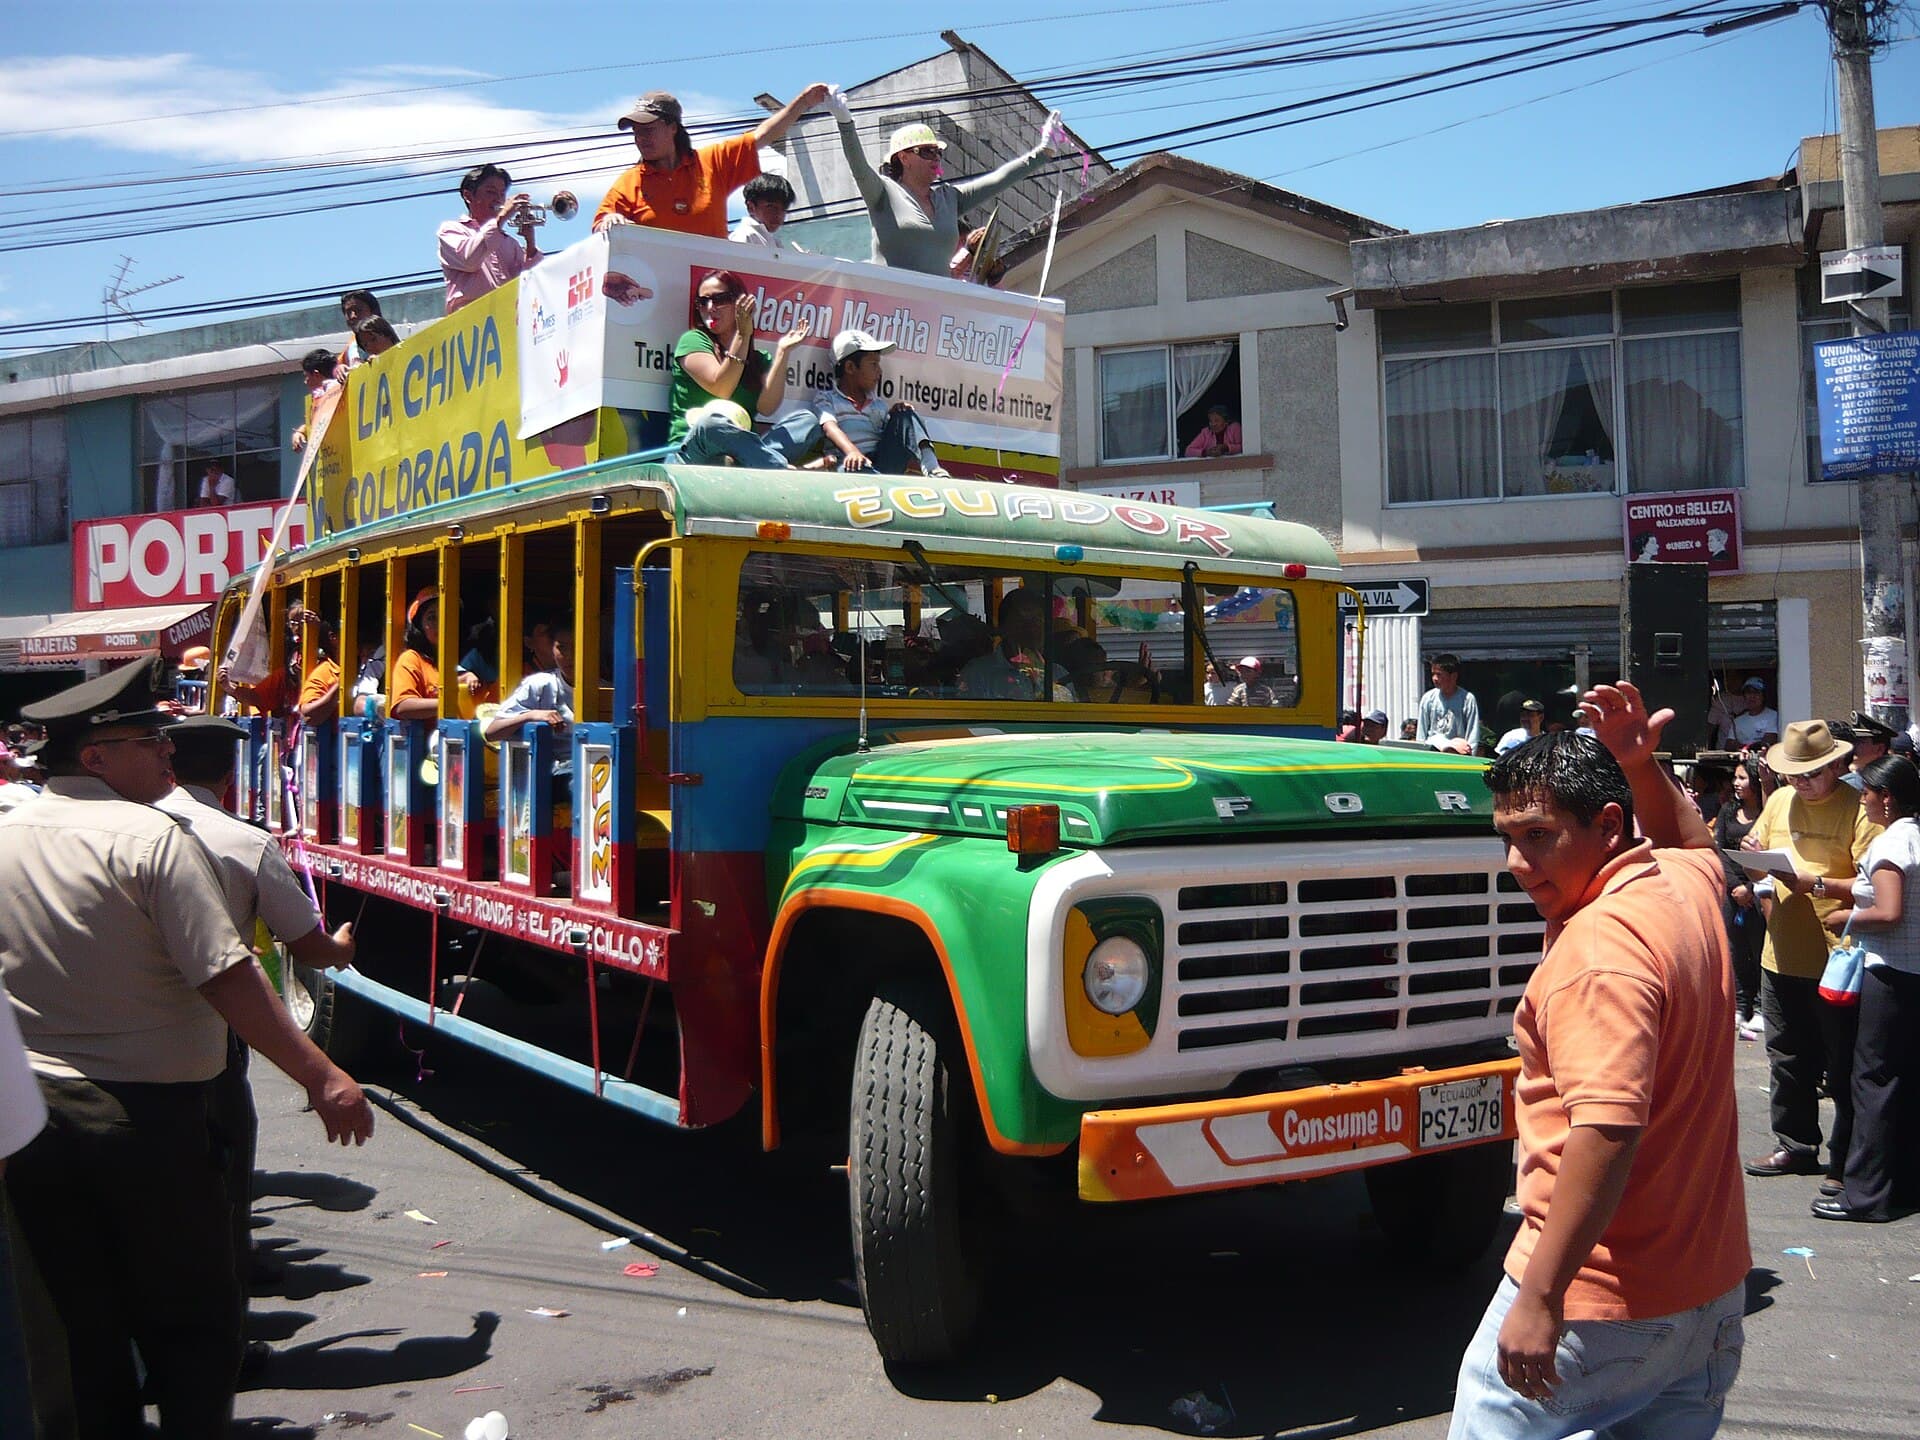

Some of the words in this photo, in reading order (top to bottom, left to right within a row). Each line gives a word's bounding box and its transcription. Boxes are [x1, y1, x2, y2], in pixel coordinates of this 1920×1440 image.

[752, 286, 833, 340] dacion
[841, 298, 930, 354] Martha
[936, 314, 1024, 369] Estrella
[1820, 342, 1860, 358] UNIDAD
[1863, 336, 1920, 352] EDUCATIVA
[1824, 353, 1877, 367] SEGUNDO
[1880, 349, 1917, 360] TORRES
[1835, 360, 1912, 375] EDUCACION
[358, 372, 393, 441] LA
[403, 315, 502, 419] CHIVA
[635, 341, 675, 371] Trab
[786, 360, 801, 386] el
[899, 376, 963, 411] Integral
[967, 385, 988, 412] de
[992, 388, 1005, 415] la
[1009, 392, 1053, 421] niñez
[1825, 370, 1908, 385] PRESENCIAL
[1846, 377, 1917, 390] DISTANCIA
[1841, 388, 1909, 401] INFORMATICA
[1841, 398, 1894, 409] MECANICA
[1842, 404, 1909, 417] AUTOMOTRIZ
[1842, 415, 1892, 426] SOCIALES
[1843, 421, 1918, 434] CONTABILIDAD
[1844, 431, 1915, 444] ELECTRONICA
[343, 419, 512, 531] COLORADA
[1629, 503, 1674, 520] CENTRO
[1675, 504, 1686, 515] DE
[1686, 500, 1733, 516] BELLEZA
[834, 486, 1234, 558] ECUADOR
[1662, 518, 1700, 528] ALEXANDRA
[1373, 592, 1394, 605] VIA
[169, 611, 212, 645] CABINAS
[21, 636, 77, 654] TARJETAS
[105, 634, 138, 647] PORTA
[1212, 790, 1472, 818] FOR
[368, 866, 388, 890] SAN
[456, 890, 472, 914] LA
[475, 896, 514, 928] RONDA
[529, 911, 549, 938] EL
[1439, 1085, 1483, 1104] ECUADOR
[1283, 1109, 1378, 1146] Consume
[1421, 1099, 1500, 1143] PSZ-978
